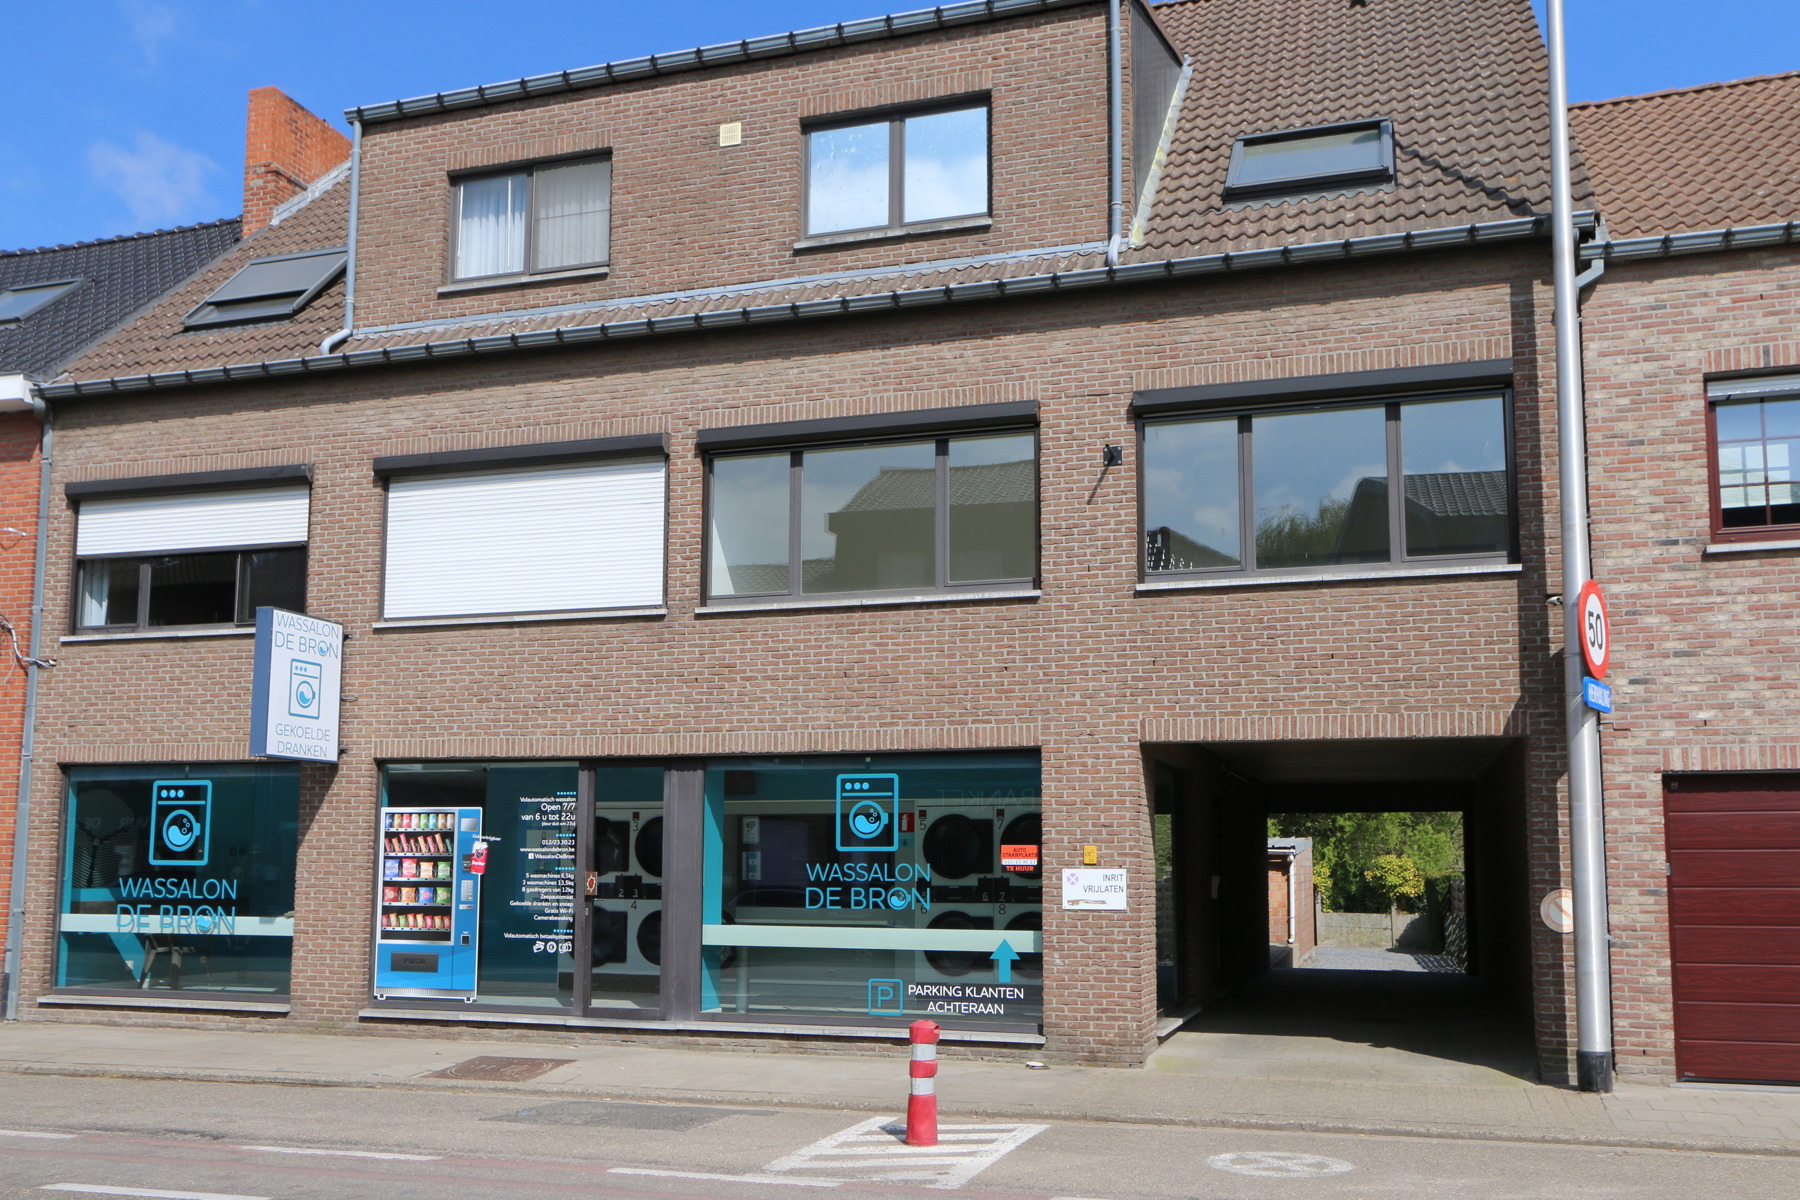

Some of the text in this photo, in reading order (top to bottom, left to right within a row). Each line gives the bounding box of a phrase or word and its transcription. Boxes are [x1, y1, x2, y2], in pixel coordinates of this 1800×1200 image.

[276, 612, 340, 640] WASSALON
[1588, 610, 1603, 650] 50
[274, 630, 339, 660] DE BRON
[275, 722, 331, 742] GEKOELDE
[277, 740, 328, 759] DRANKEN
[535, 812, 541, 820] 6
[548, 812, 560, 820] tot
[561, 812, 576, 820] 22u
[541, 802, 576, 812] Open 7/7
[805, 862, 932, 882] WASSALON
[1102, 873, 1124, 882] INRIT
[118, 877, 238, 900] WASSALON
[1082, 884, 1124, 893] VRIJLATEN
[804, 887, 932, 911] DE BRON
[115, 903, 236, 932] DE BRON
[533, 914, 574, 923] Camerabewaking
[539, 932, 573, 940] betaalsysteem
[403, 957, 426, 965] PUSH
[877, 985, 894, 1008] P
[907, 984, 1025, 999] PARKING KLANTEN
[926, 1001, 1005, 1015] ACHTERAAN
